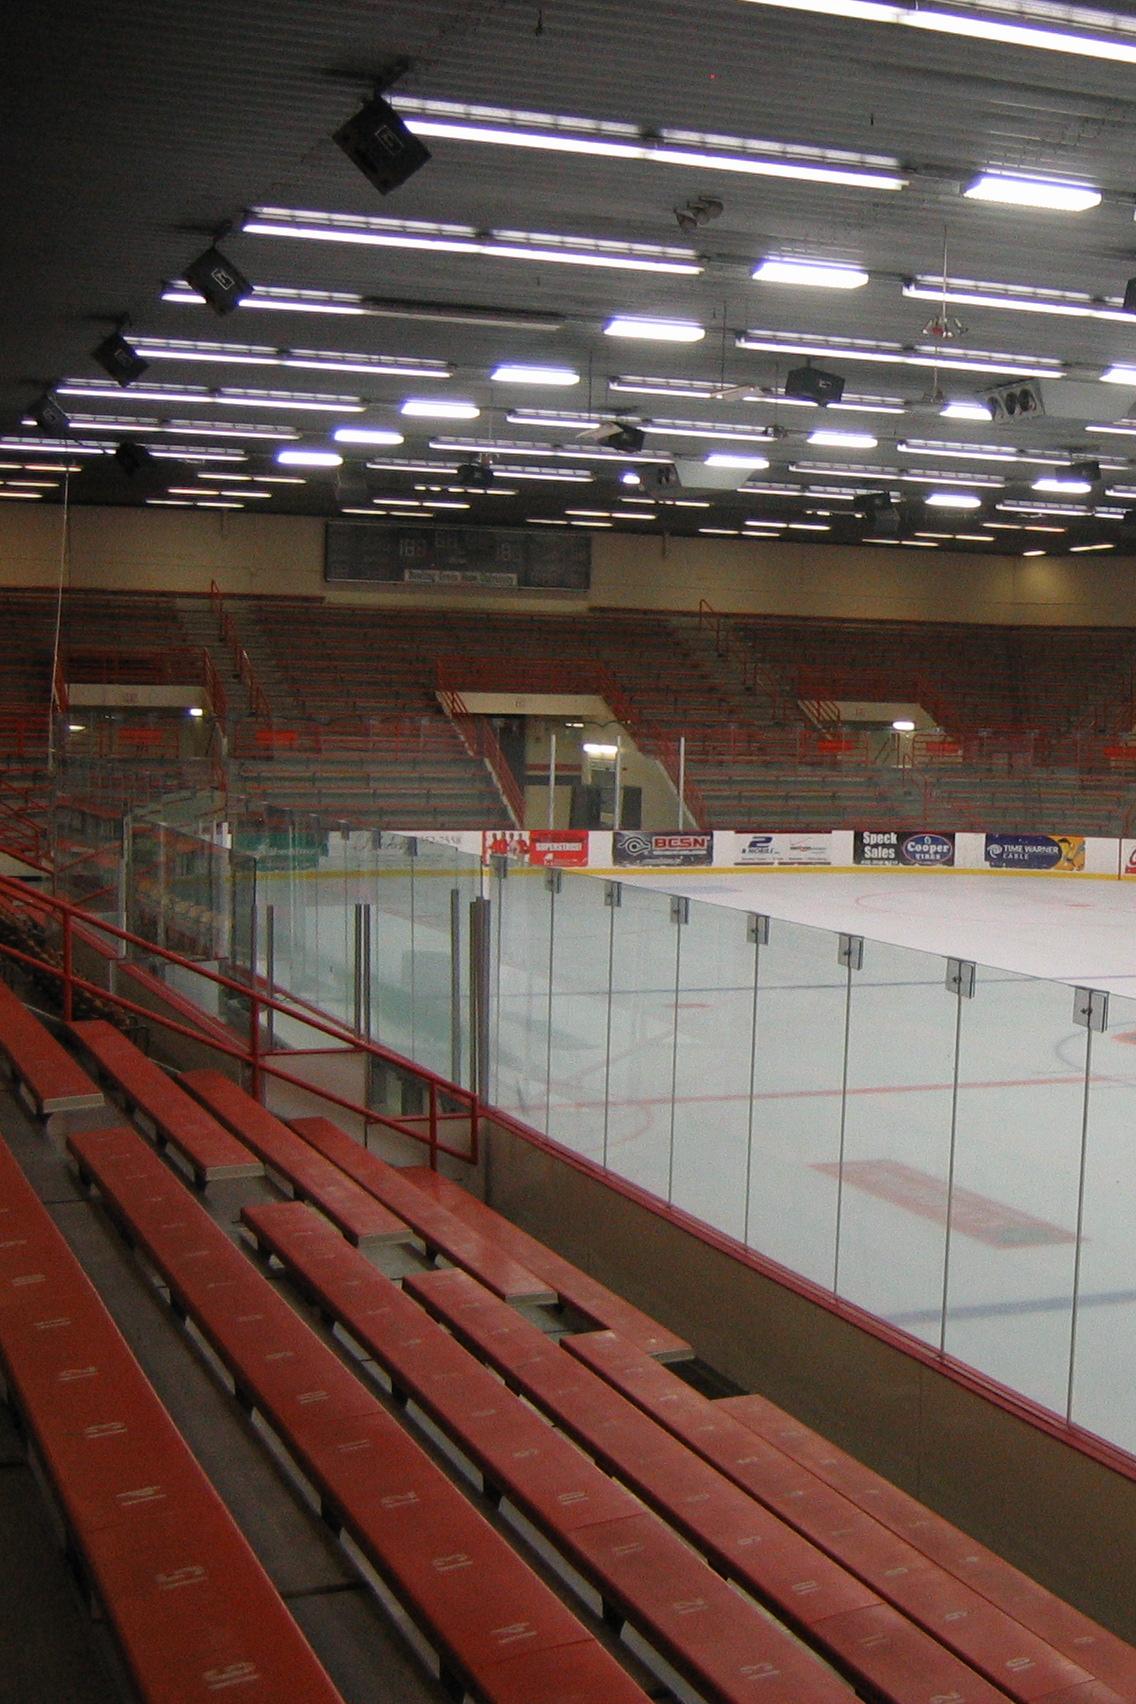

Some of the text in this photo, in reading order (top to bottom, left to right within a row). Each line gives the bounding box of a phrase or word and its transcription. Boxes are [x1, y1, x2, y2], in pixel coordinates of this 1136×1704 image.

[652, 836, 708, 850] BCSN
[862, 831, 898, 845] Speck
[864, 845, 896, 859] Sales
[906, 841, 950, 853] Cooper
[1003, 844, 1059, 854] TIME WARNER
